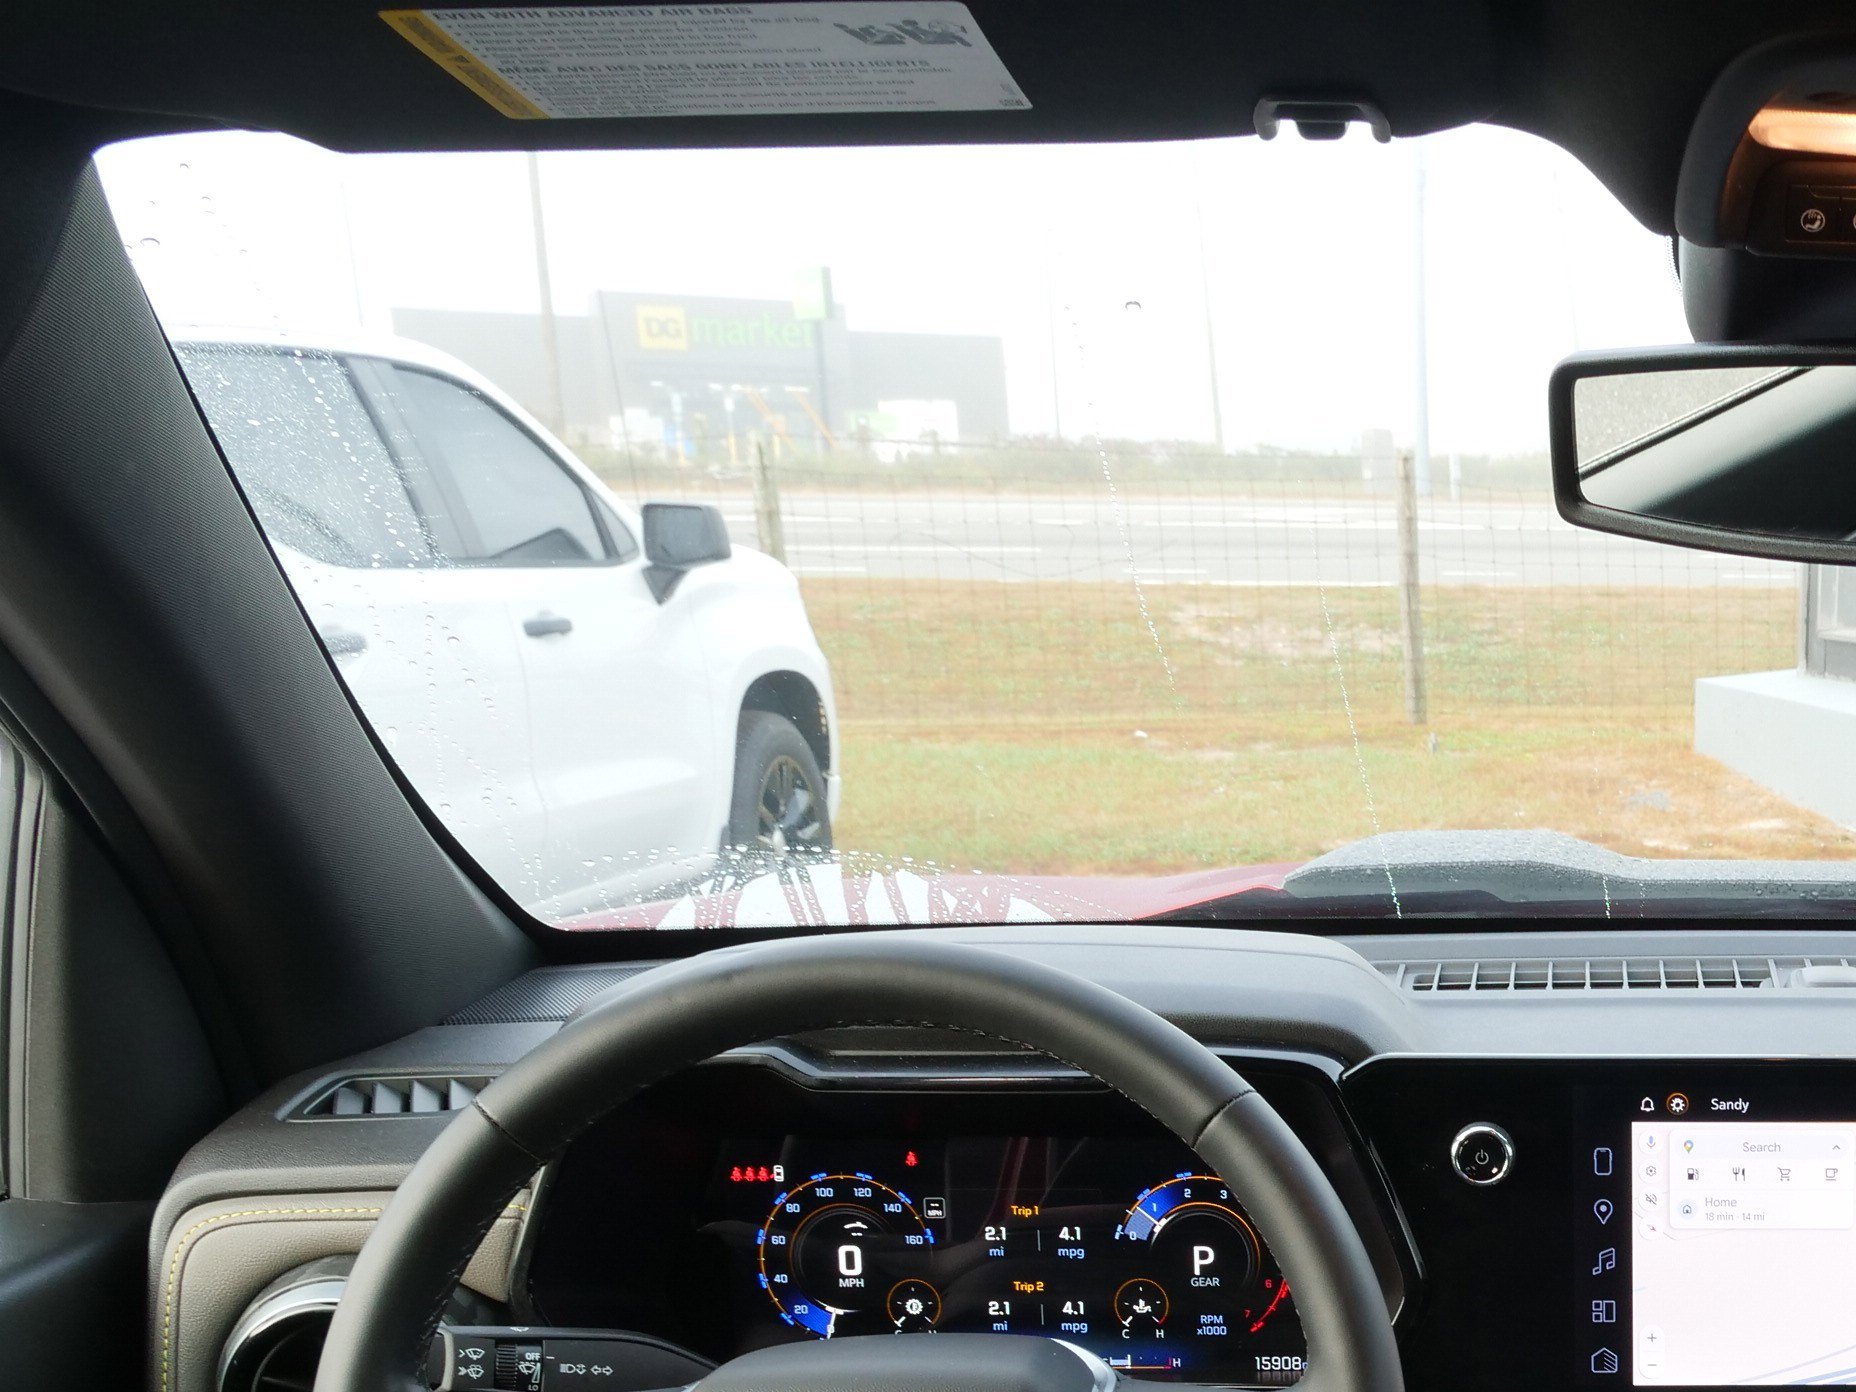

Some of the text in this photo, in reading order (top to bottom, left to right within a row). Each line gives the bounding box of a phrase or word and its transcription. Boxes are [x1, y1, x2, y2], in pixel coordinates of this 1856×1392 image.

[644, 312, 814, 348] DG market
[1710, 1098, 1749, 1113] Sandy
[1742, 1142, 1782, 1153] Search
[815, 1187, 834, 1198] 100
[853, 1187, 872, 1198] 120
[1183, 1188, 1192, 1198] 2
[1219, 1189, 1228, 1200] 3
[785, 1203, 801, 1213] 80
[884, 1203, 902, 1213] 140
[1152, 1202, 1158, 1212] 1
[1705, 1197, 1738, 1208] Home
[1011, 1205, 1040, 1218] Trip 1
[1705, 1212, 1765, 1221] 18 min 14 mi
[984, 1226, 1007, 1241] 2.1
[1058, 1226, 1082, 1241] 4.1
[771, 1235, 786, 1245] 60
[905, 1235, 924, 1245] 160
[988, 1246, 1005, 1257] mi
[1057, 1247, 1085, 1259] mpg
[837, 1244, 863, 1276] 0
[1193, 1245, 1215, 1276] P
[773, 1273, 788, 1284] 40
[838, 1278, 865, 1288] MPH
[1190, 1277, 1221, 1287] GEAR
[1264, 1279, 1272, 1289] 6
[1013, 1281, 1045, 1293] Trip 2
[794, 1304, 809, 1314] 20
[988, 1301, 1011, 1316] 2.1
[1061, 1301, 1085, 1316] 4.1
[1200, 1315, 1224, 1324] RPM
[992, 1320, 1009, 1332] mi
[1061, 1321, 1089, 1334] mpg
[1196, 1326, 1228, 1336] x1000
[1121, 1329, 1130, 1339] C
[1155, 1329, 1165, 1339] H
[525, 1352, 541, 1361] OFF
[1172, 1358, 1181, 1368] H
[528, 1384, 539, 1392] LO
